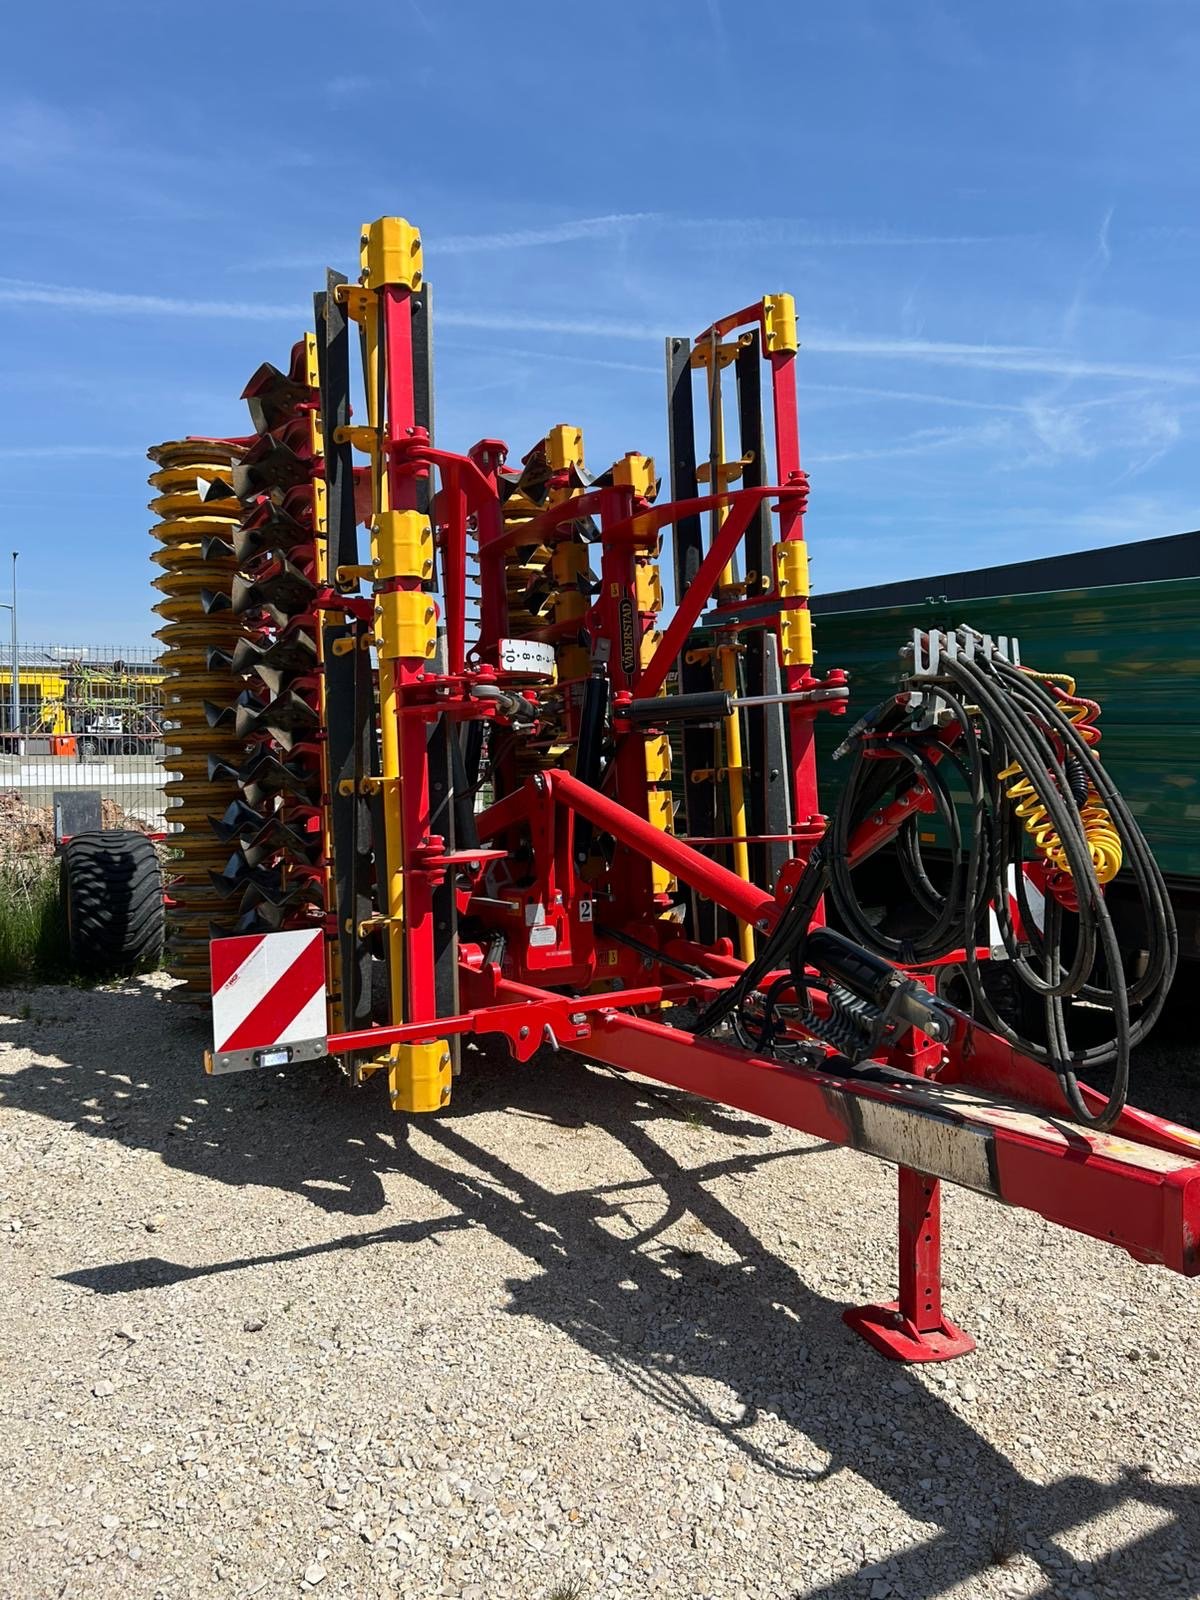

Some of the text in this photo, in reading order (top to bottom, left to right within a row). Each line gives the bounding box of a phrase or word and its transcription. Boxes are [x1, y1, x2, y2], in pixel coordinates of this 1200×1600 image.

[622, 603, 634, 669] VÄDERSTAD
[505, 648, 515, 663] 10
[581, 902, 590, 918] 2
